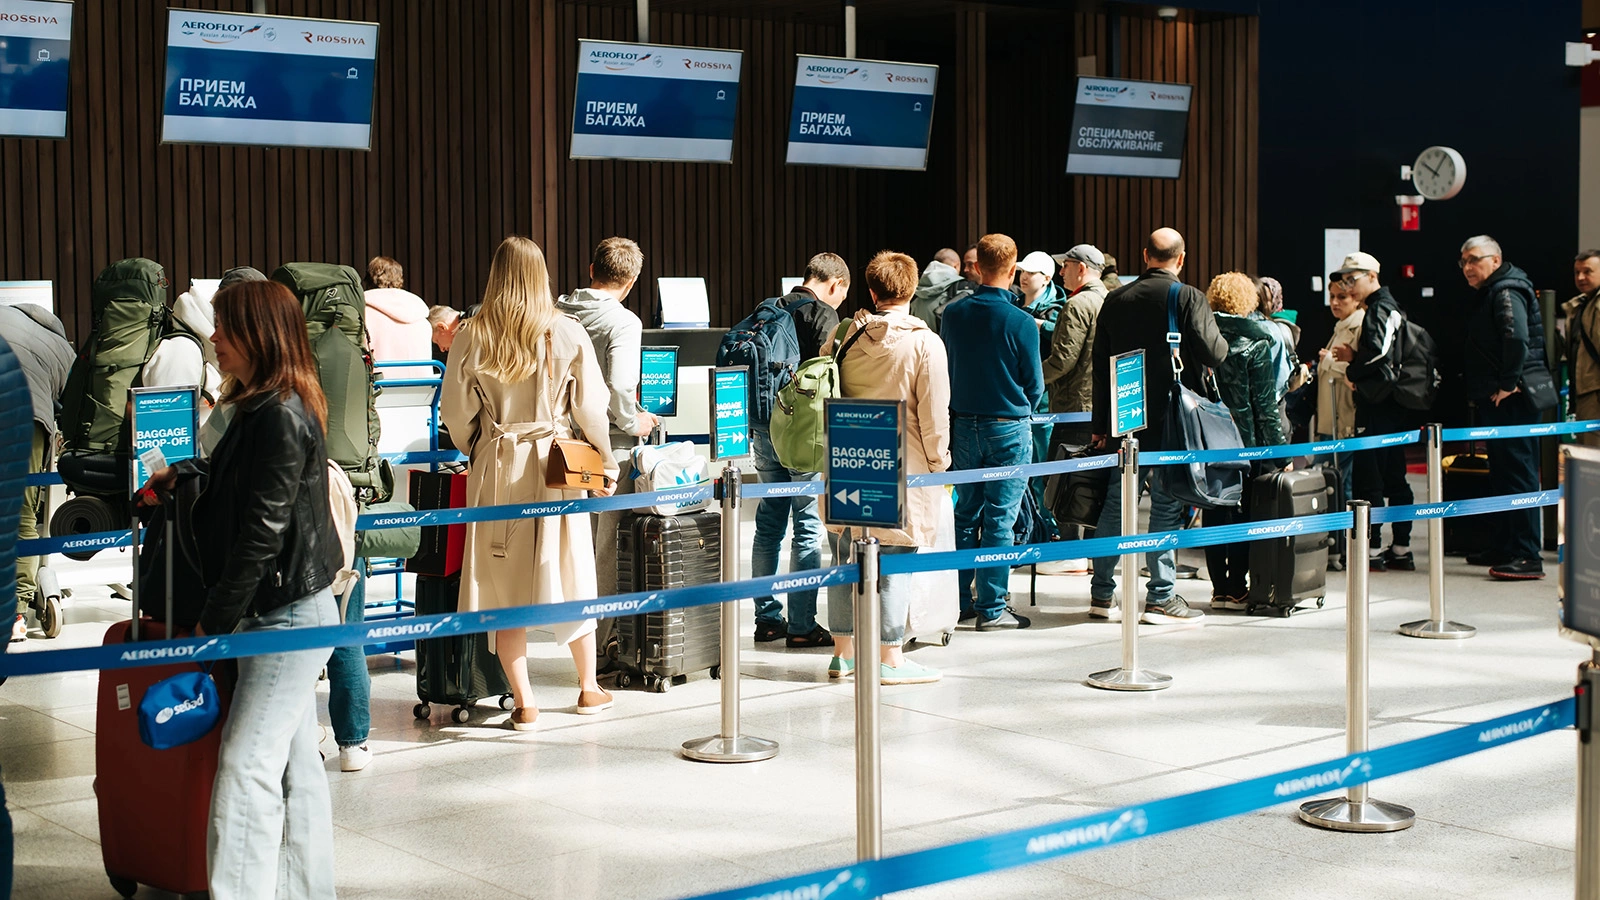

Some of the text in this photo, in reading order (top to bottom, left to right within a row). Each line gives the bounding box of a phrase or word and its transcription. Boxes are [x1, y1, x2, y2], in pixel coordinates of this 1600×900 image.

[0, 13, 58, 25] ROSSIYA
[181, 21, 244, 33] AEROFLOT
[316, 35, 366, 45] ROSSIYA
[589, 50, 638, 60] AEROFLOT
[694, 61, 733, 71] ROSSIYA
[806, 65, 848, 74] AEROFLOT
[895, 75, 929, 84] ROSSIYA
[179, 78, 246, 95] ПРИЕМ
[178, 92, 258, 109] БАГАЖА
[586, 101, 638, 115] ПРИЕМ
[585, 114, 646, 128] БАГАЖА
[801, 111, 846, 125] ПРИЕМ
[799, 123, 852, 137] БАГАЖА
[1079, 126, 1155, 141] СПЕЦИАЛЬНОЕ
[1077, 137, 1164, 152] ОБСЛУЖИВАНИЕ
[136, 427, 188, 440] BAGGAGE
[136, 436, 192, 449] DROP-OFF
[832, 446, 891, 459] BAGGAGE
[832, 458, 895, 470] DROP-OFF
[1077, 460, 1104, 468] AEROFLOT
[981, 471, 1011, 479] AEROFLOT
[766, 486, 801, 494] AEROFLOT
[655, 492, 694, 502] AEROFLOT
[521, 505, 562, 515] AEROFLOT
[1415, 507, 1445, 516] AEROFLOT
[373, 516, 418, 526] AEROFLOT
[1247, 524, 1285, 535] AEROFLOT
[62, 536, 117, 549] AEROFLOT
[1117, 539, 1159, 550] AEROFLOT
[974, 551, 1020, 563] AEROFLOT
[771, 574, 823, 591] AEROFLOT
[581, 600, 640, 615] AEROFLOT
[366, 622, 432, 638] AEROFLOT
[120, 645, 196, 660] AEROFLOT
[1273, 768, 1341, 797] AEROFLOT
[1026, 821, 1111, 855] AEROFLOT
